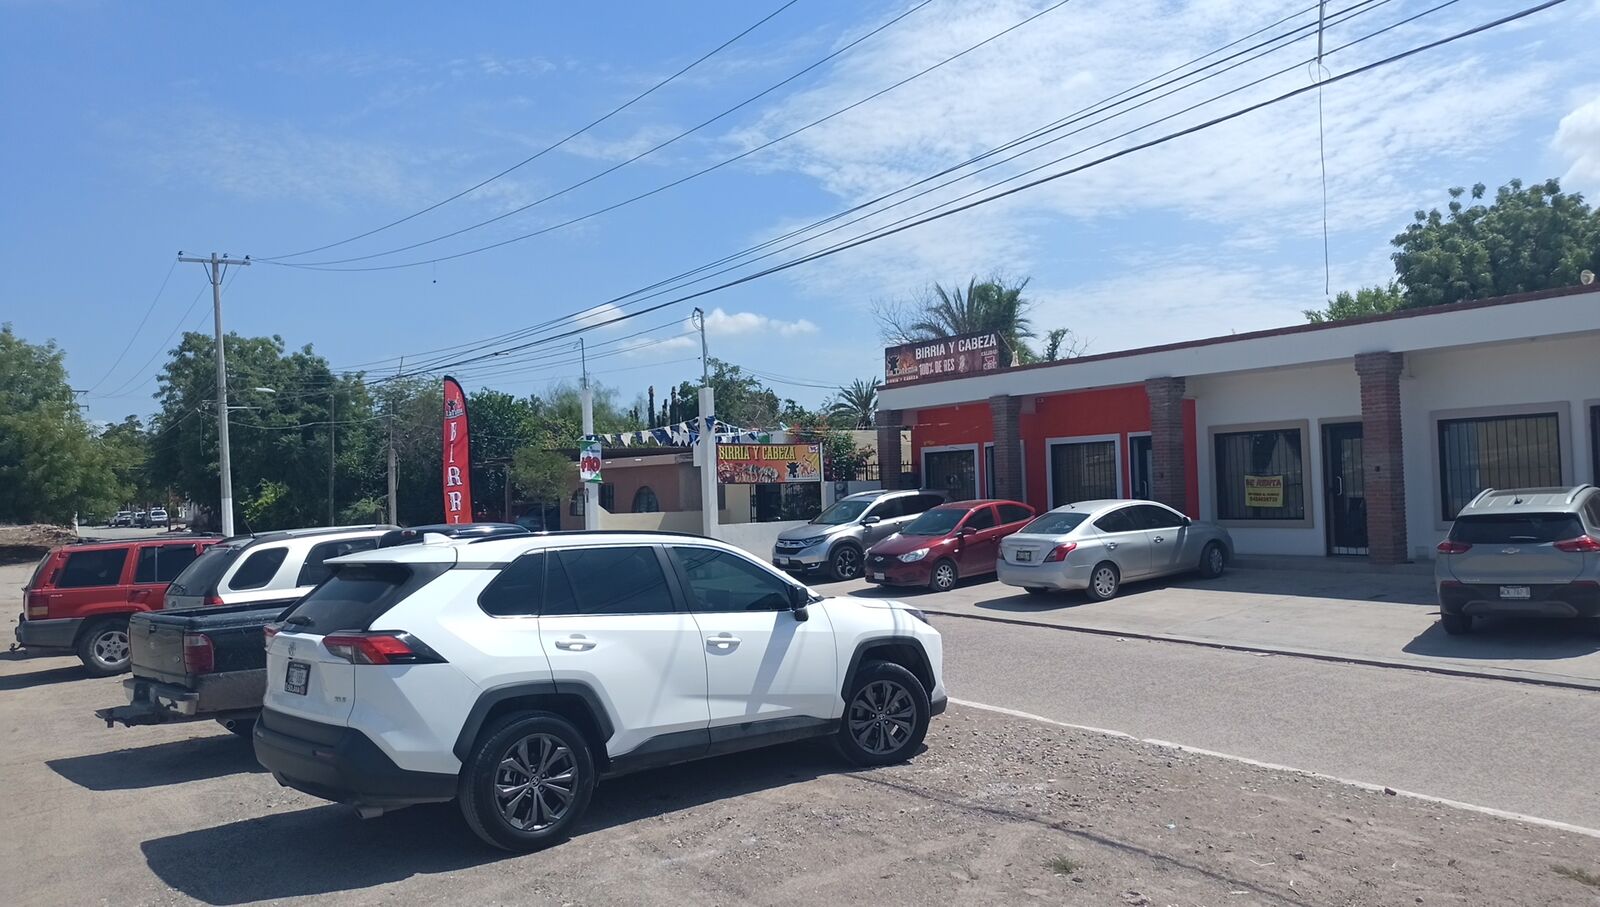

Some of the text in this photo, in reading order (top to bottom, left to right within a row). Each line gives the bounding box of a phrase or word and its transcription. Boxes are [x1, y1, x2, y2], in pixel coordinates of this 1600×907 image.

[915, 334, 997, 360] BIRRIA Y CABEZA
[919, 358, 955, 376] 100% DE RES
[752, 445, 759, 460] Y
[762, 445, 796, 460] CABEZA
